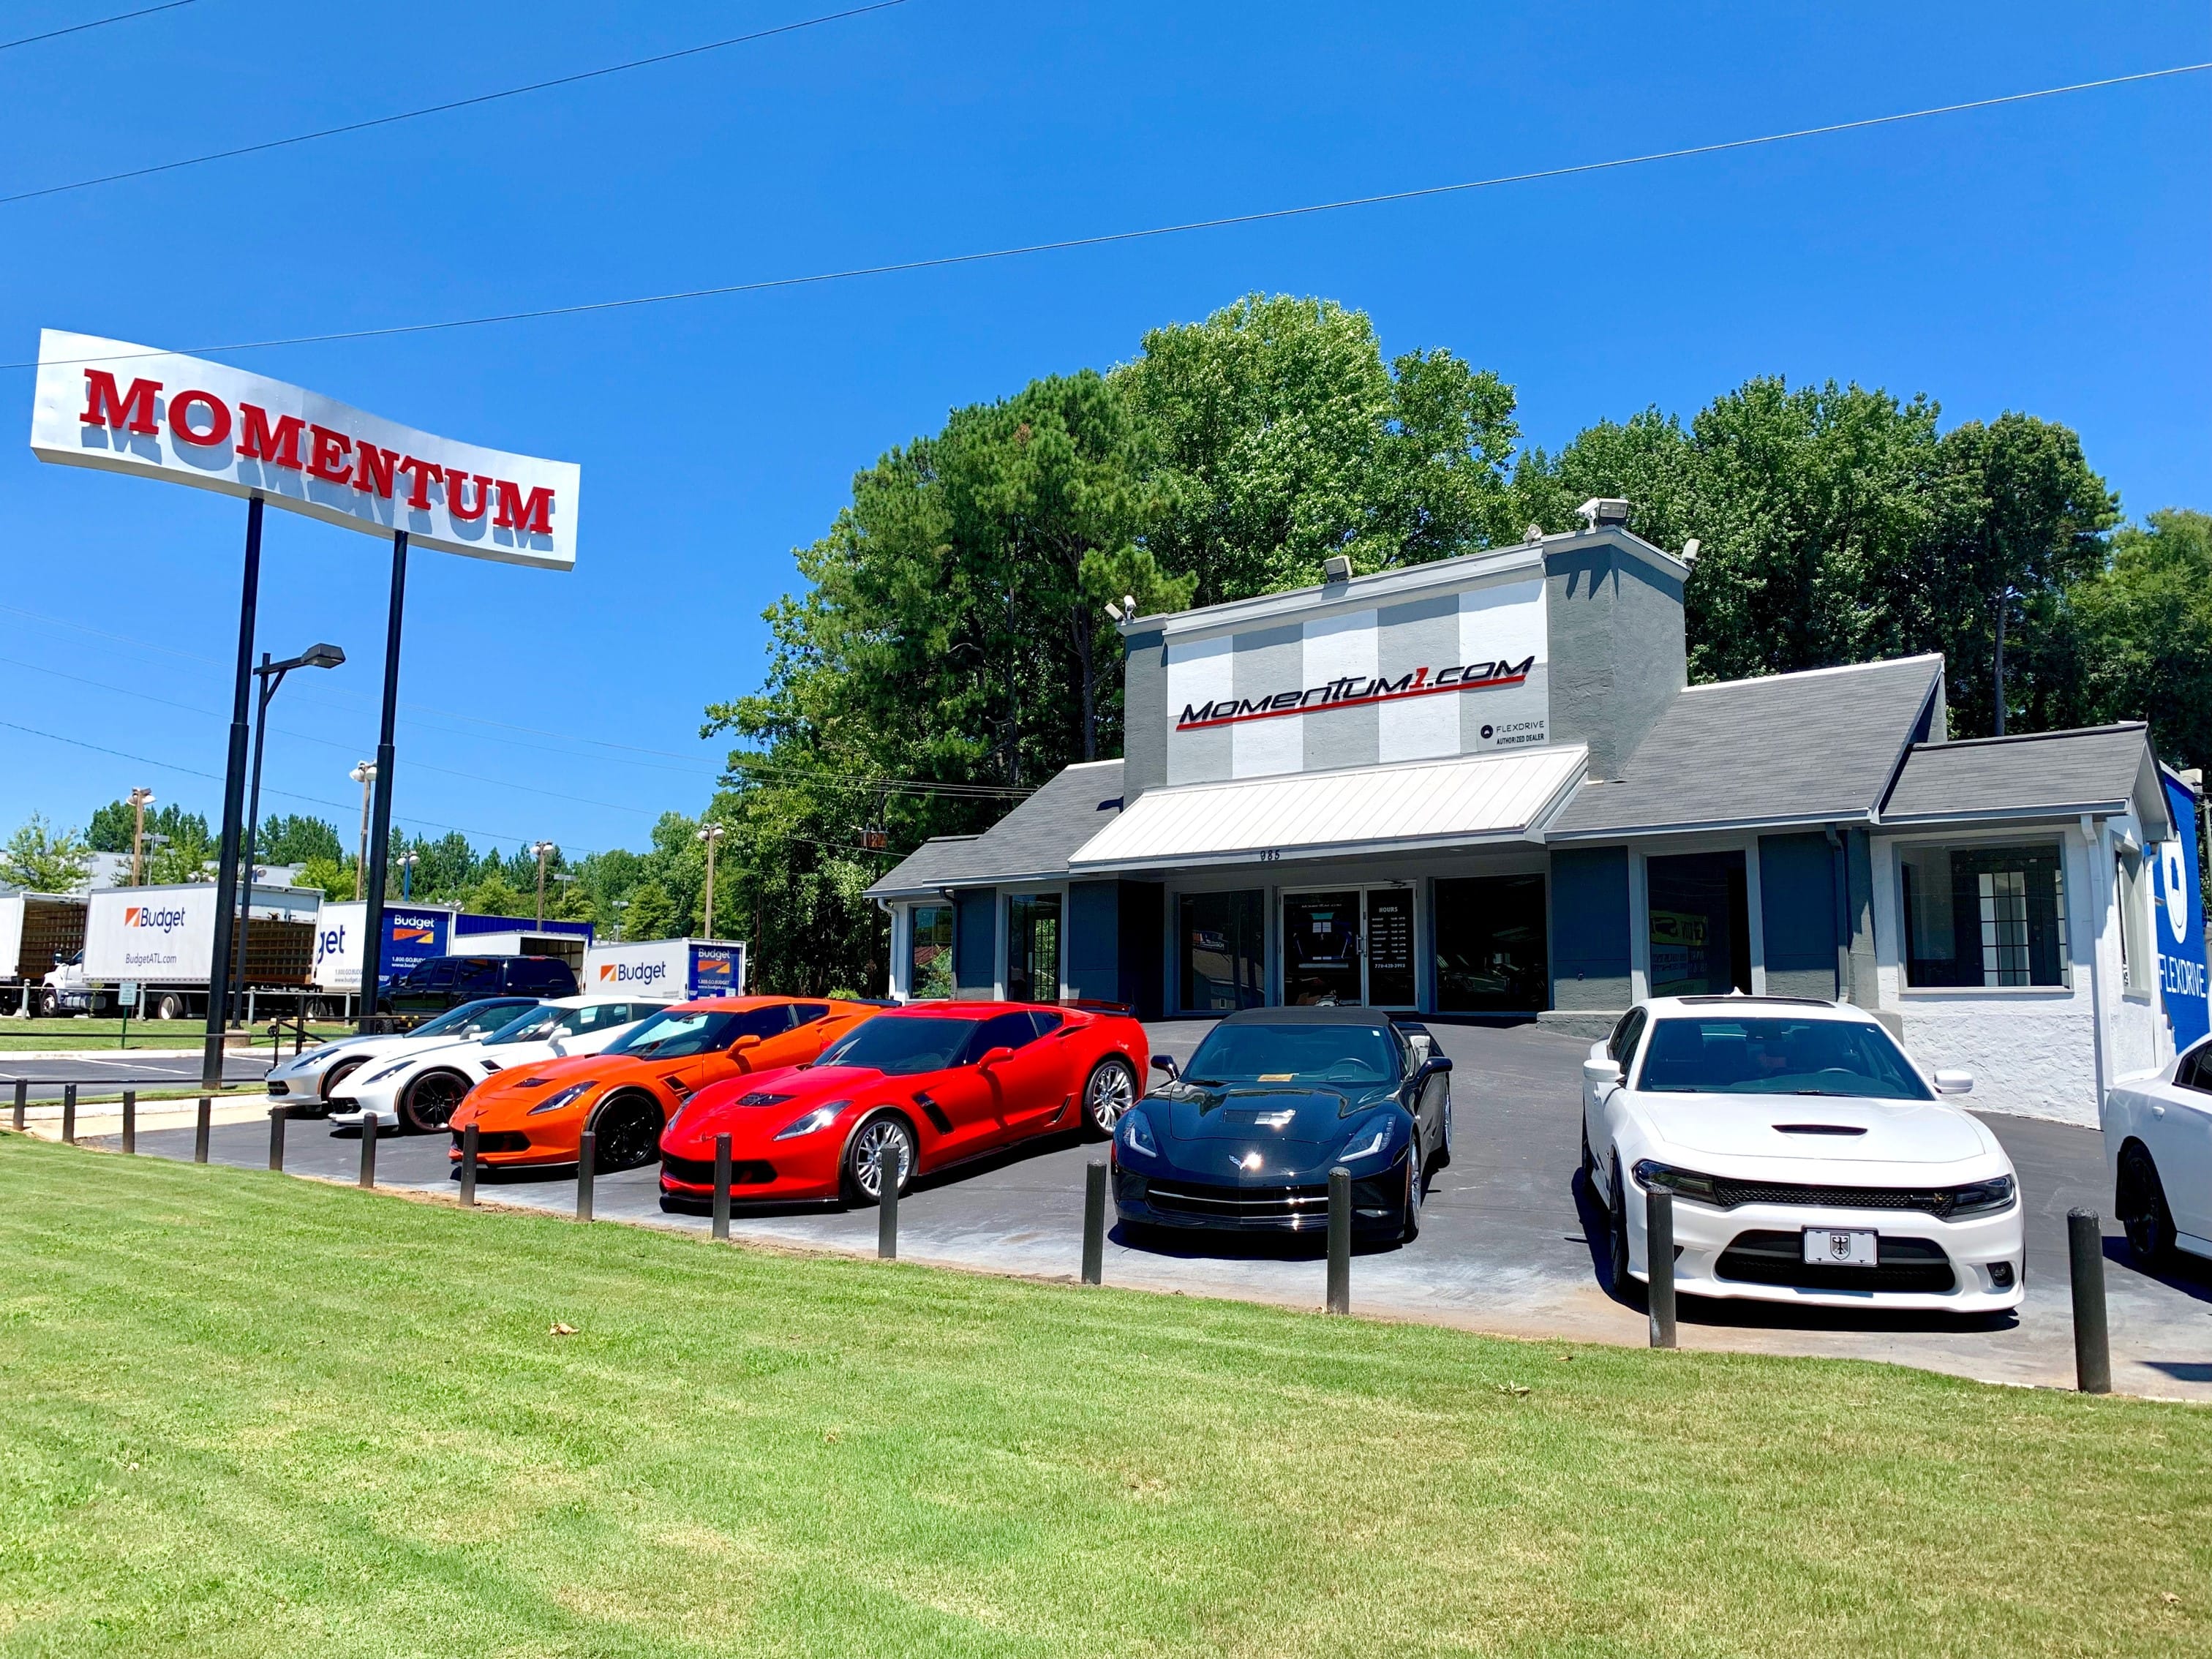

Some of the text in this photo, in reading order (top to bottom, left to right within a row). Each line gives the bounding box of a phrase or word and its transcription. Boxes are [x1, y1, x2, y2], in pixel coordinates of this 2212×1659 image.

[79, 369, 555, 535] MOMENTUM
[1496, 721, 1544, 733] FLEXDRIVE
[1497, 733, 1544, 745] AUTHORIZED DEALER
[1260, 849, 1280, 861] 985
[140, 907, 186, 933] Budget
[394, 914, 434, 930] Budget
[125, 953, 177, 966] BudgetATL.com
[698, 948, 730, 960] Budget
[617, 960, 666, 985] Budget
[2158, 953, 2206, 998] FLEXDRIVE
